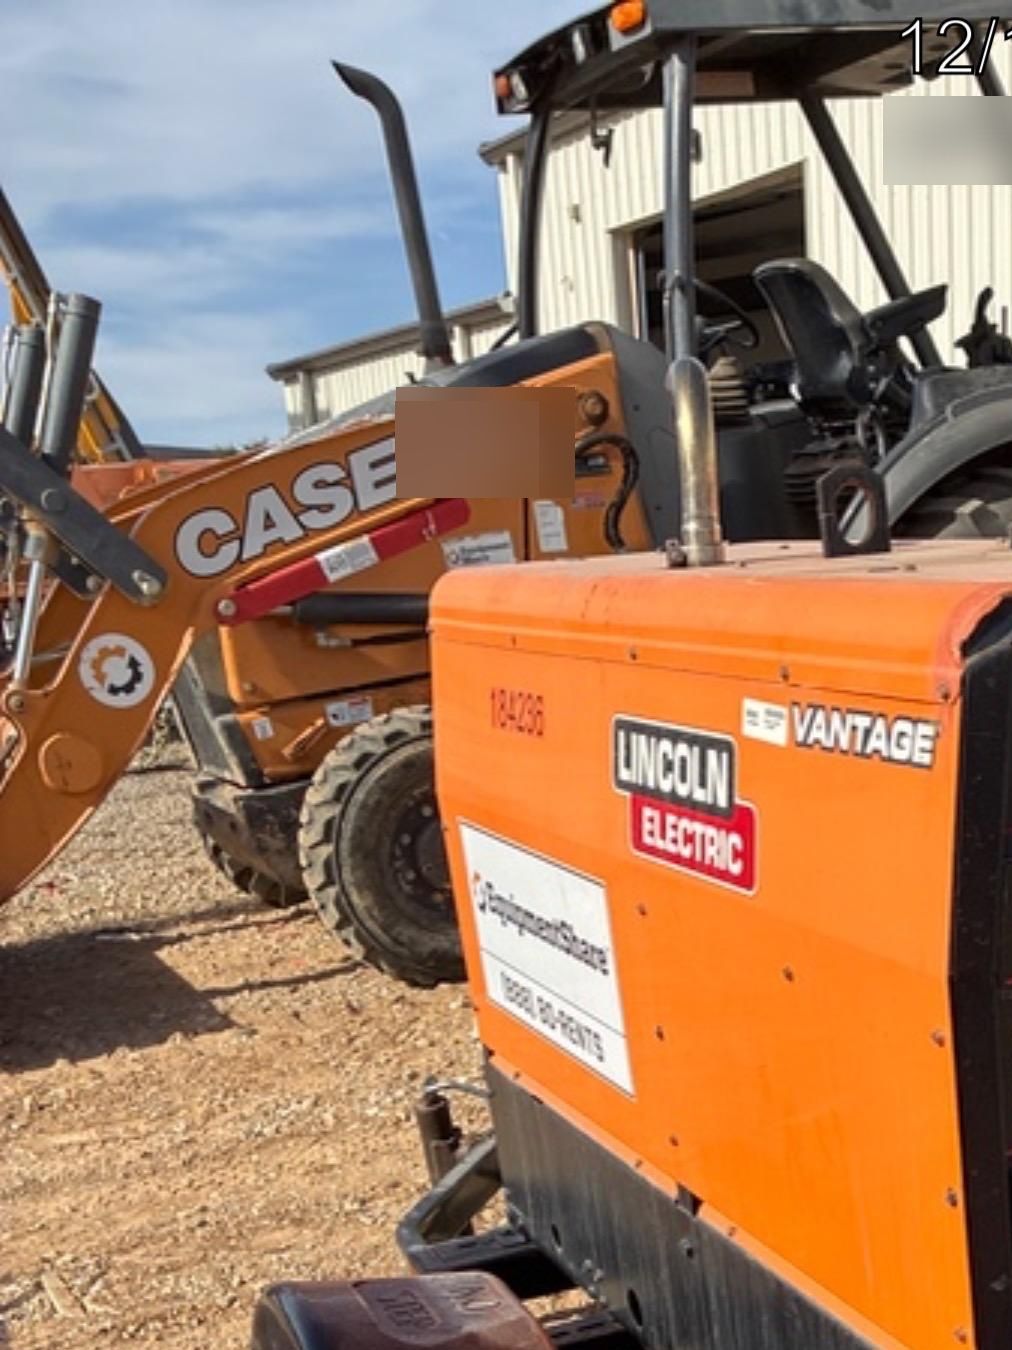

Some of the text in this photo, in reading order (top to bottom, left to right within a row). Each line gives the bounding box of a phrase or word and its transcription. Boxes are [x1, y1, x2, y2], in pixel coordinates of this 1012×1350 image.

[174, 435, 396, 578] CASE
[617, 729, 731, 809] LINCOLN
[791, 702, 939, 770] VANTAGE
[640, 806, 744, 877] ELECTRIC
